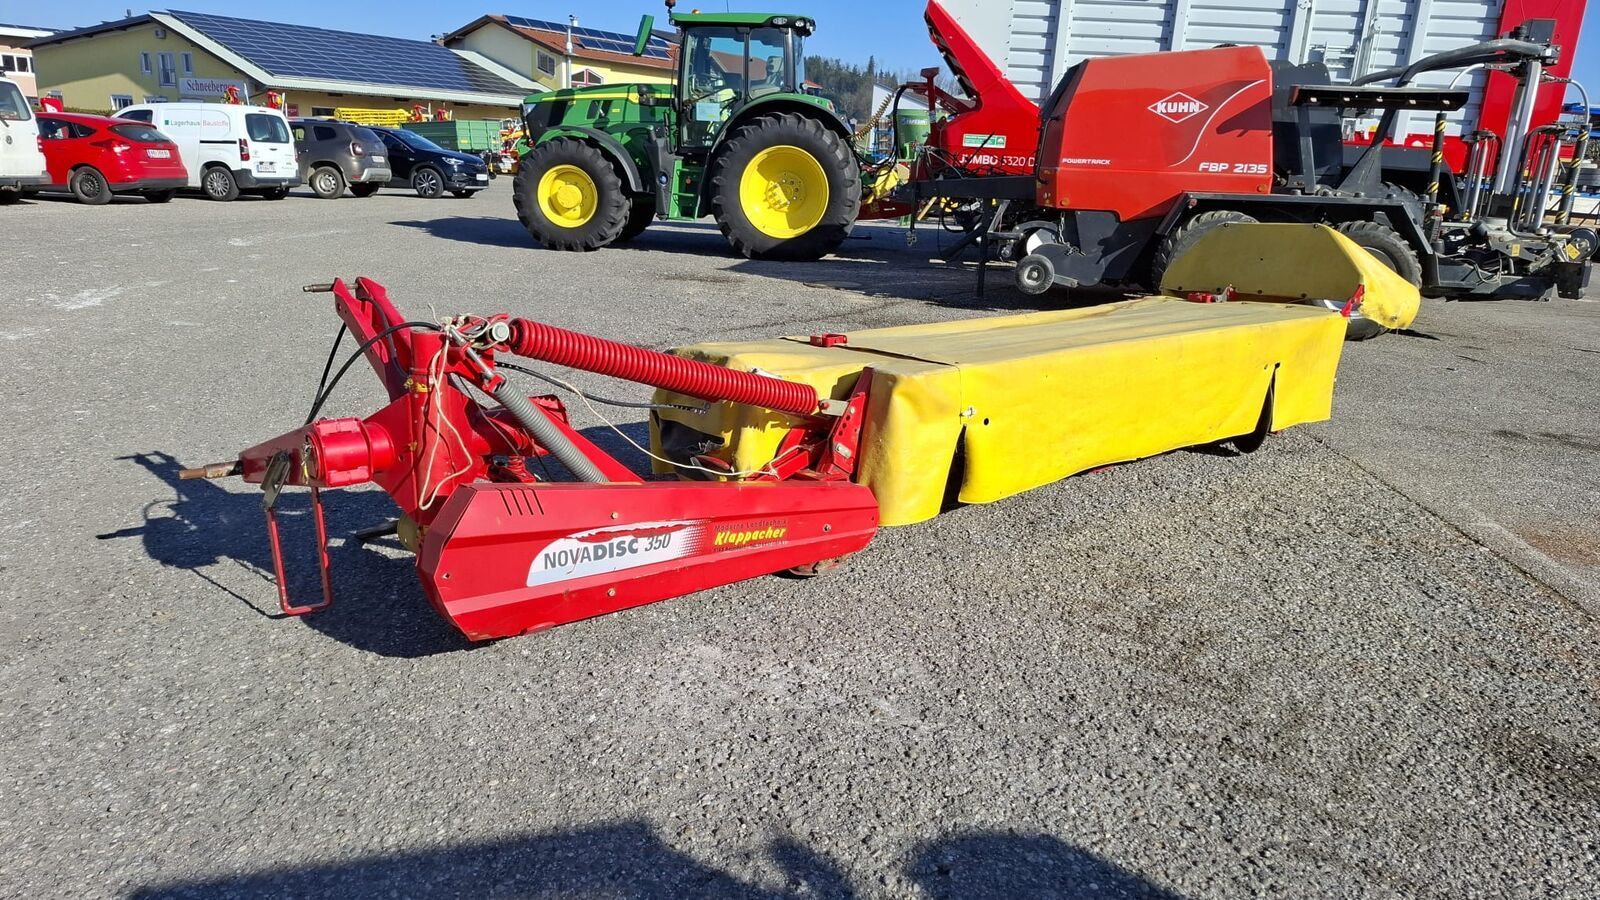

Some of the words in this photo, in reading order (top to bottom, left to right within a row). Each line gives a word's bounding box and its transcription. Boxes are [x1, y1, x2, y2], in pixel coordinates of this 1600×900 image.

[1156, 101, 1201, 114] KUHN
[170, 119, 201, 127] Lagerhaus
[202, 119, 229, 127] Baustoffe
[1062, 157, 1111, 165] POWERTRACK
[1198, 162, 1229, 173] FBP
[1232, 163, 1269, 174] 2135
[714, 525, 787, 546] Klappacher
[544, 538, 639, 570] NOVADISC
[644, 533, 672, 552] 350
